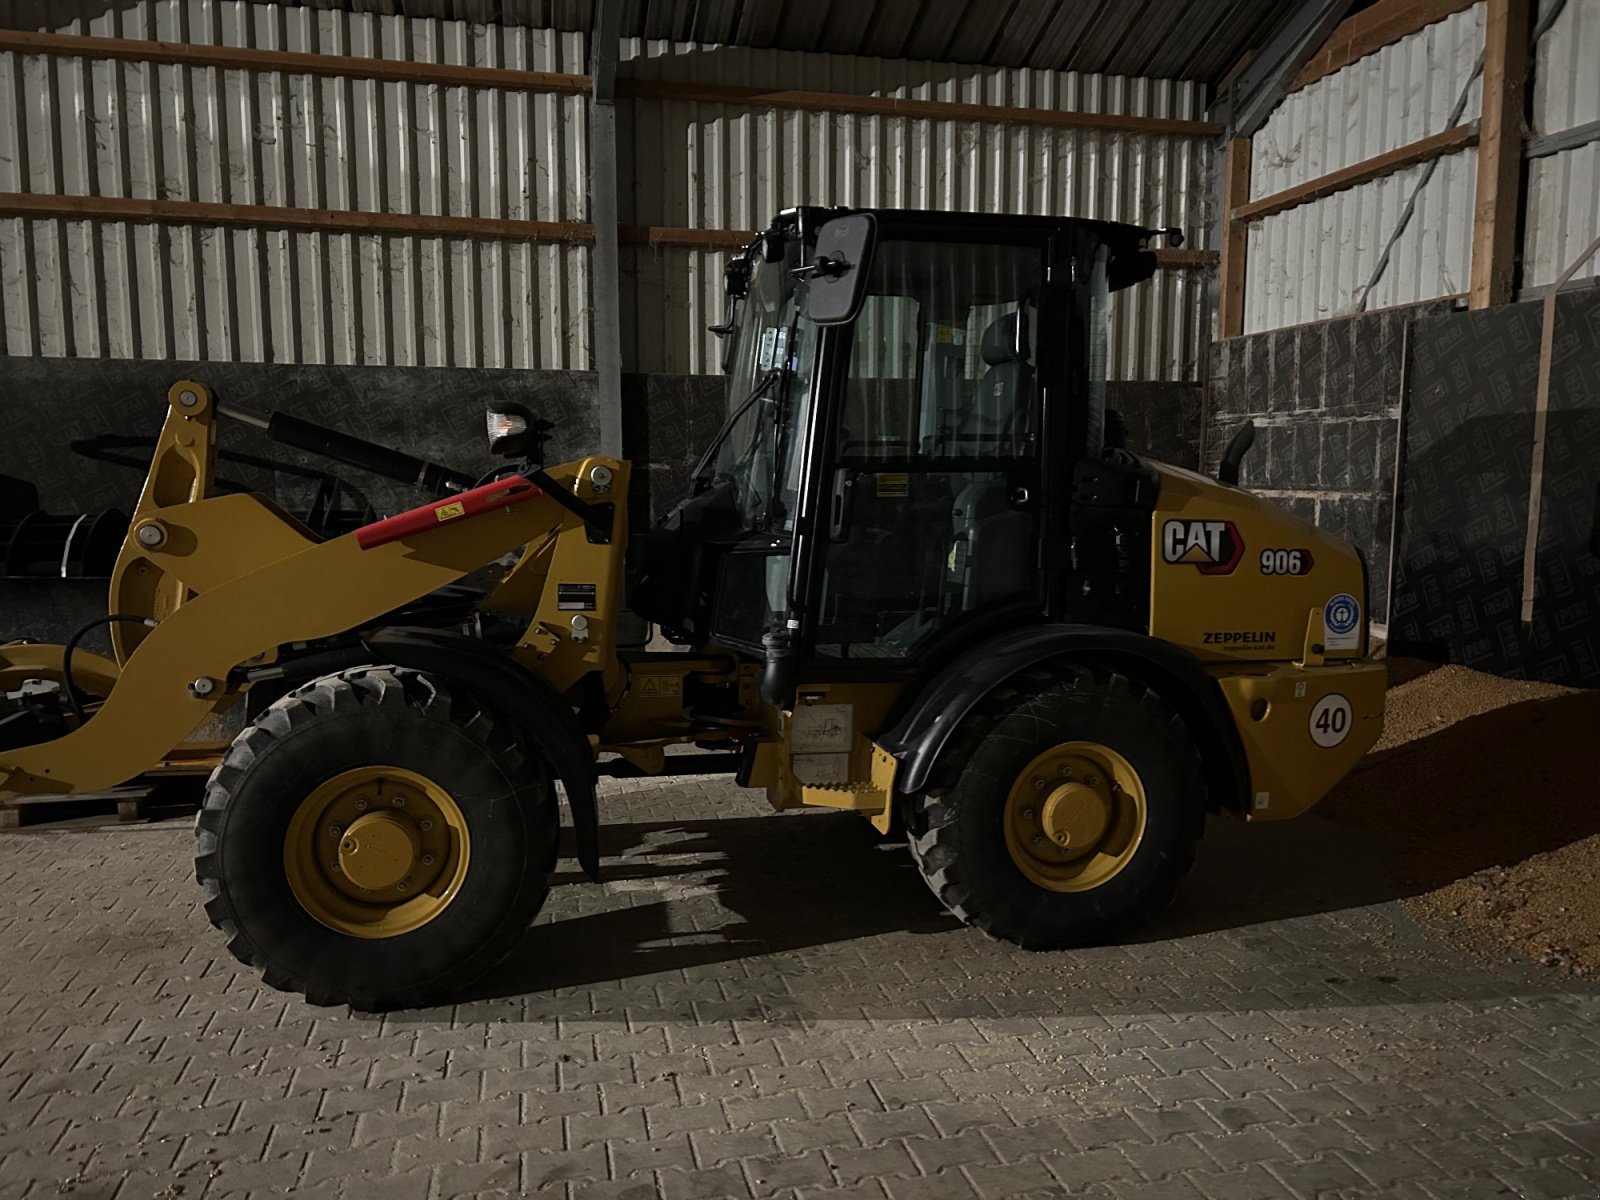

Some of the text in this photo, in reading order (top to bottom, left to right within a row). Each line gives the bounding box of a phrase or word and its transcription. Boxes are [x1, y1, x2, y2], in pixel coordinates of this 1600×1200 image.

[1164, 521, 1225, 562] CAT
[1261, 551, 1301, 574] 906
[1203, 631, 1276, 644] ZEPPELIN
[1316, 707, 1346, 733] 40
